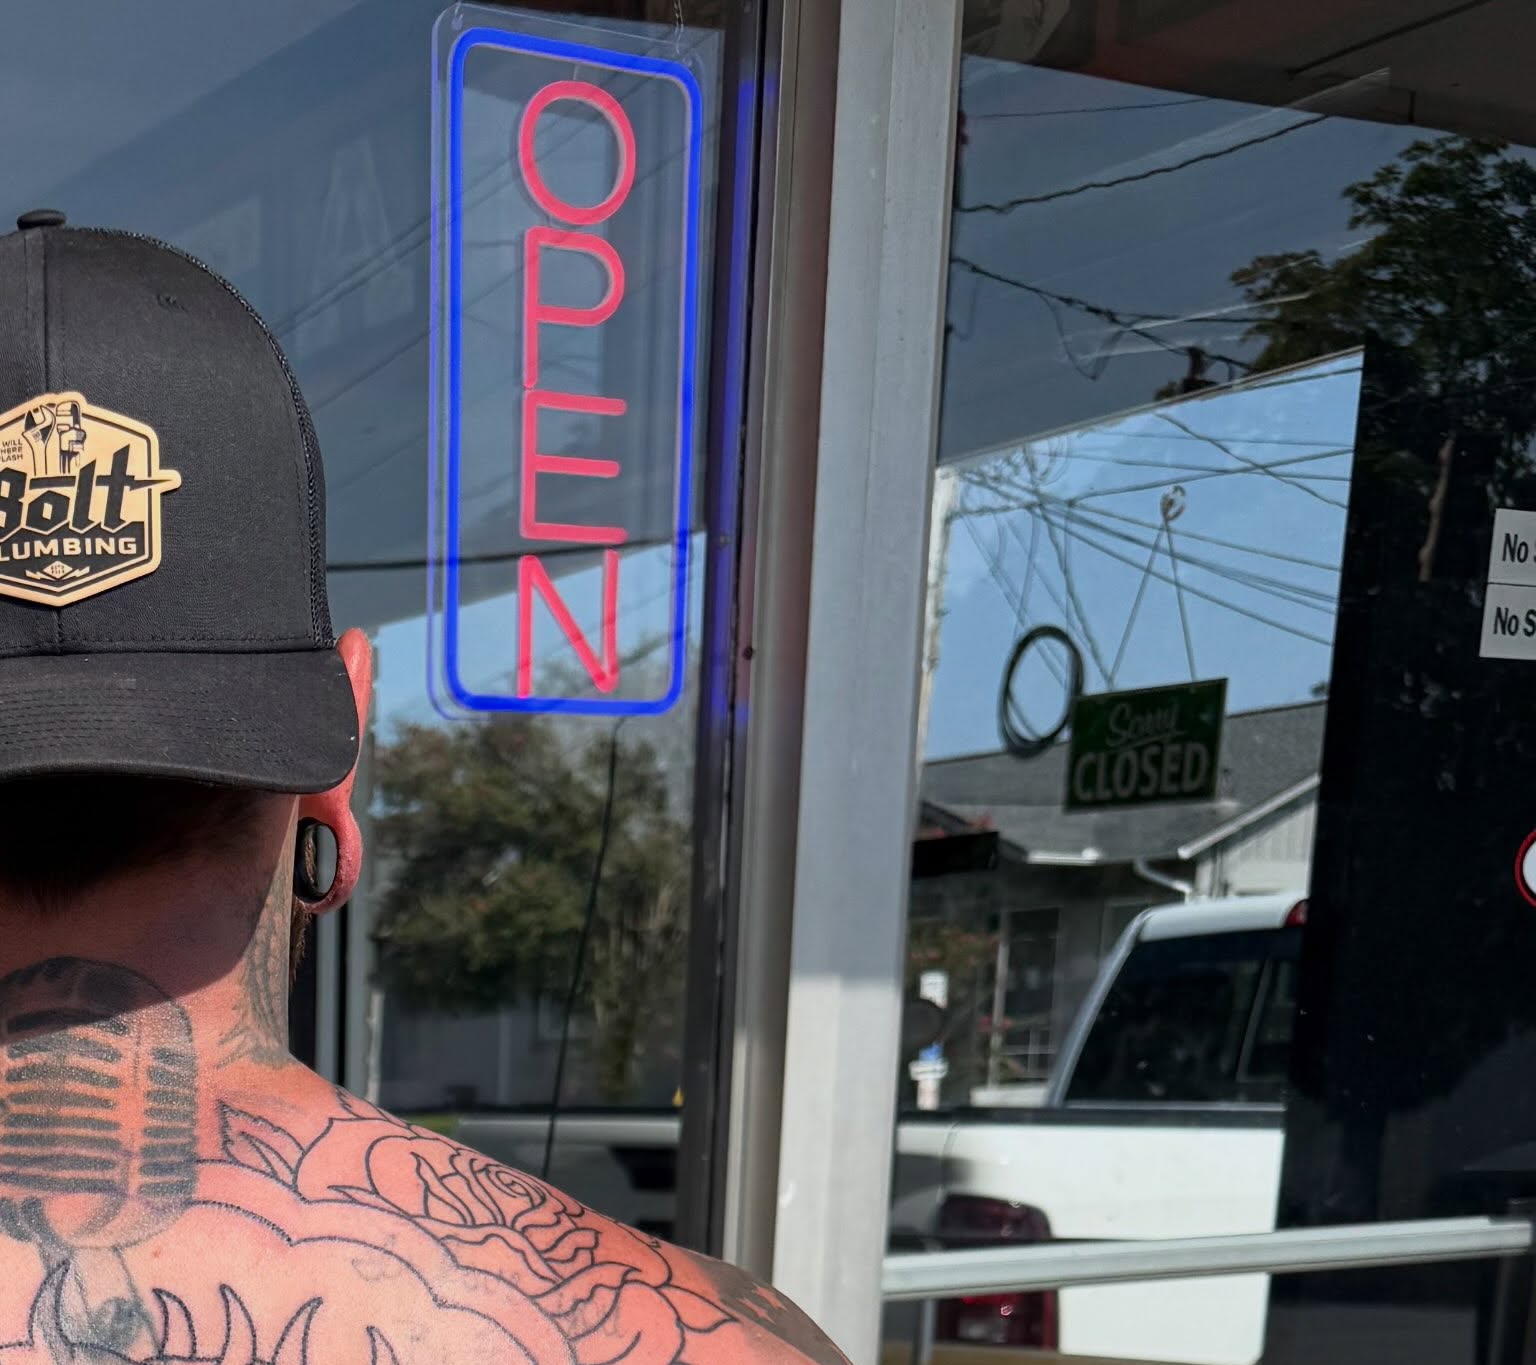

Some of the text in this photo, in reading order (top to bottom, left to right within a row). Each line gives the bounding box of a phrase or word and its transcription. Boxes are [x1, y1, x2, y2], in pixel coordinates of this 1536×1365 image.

[517, 79, 636, 698] OPEN
[2, 439, 22, 448] WILL
[1502, 532, 1529, 563] No
[1493, 606, 1519, 637] No
[1105, 702, 1185, 750] Sorry
[1073, 742, 1210, 801] CLOSED
